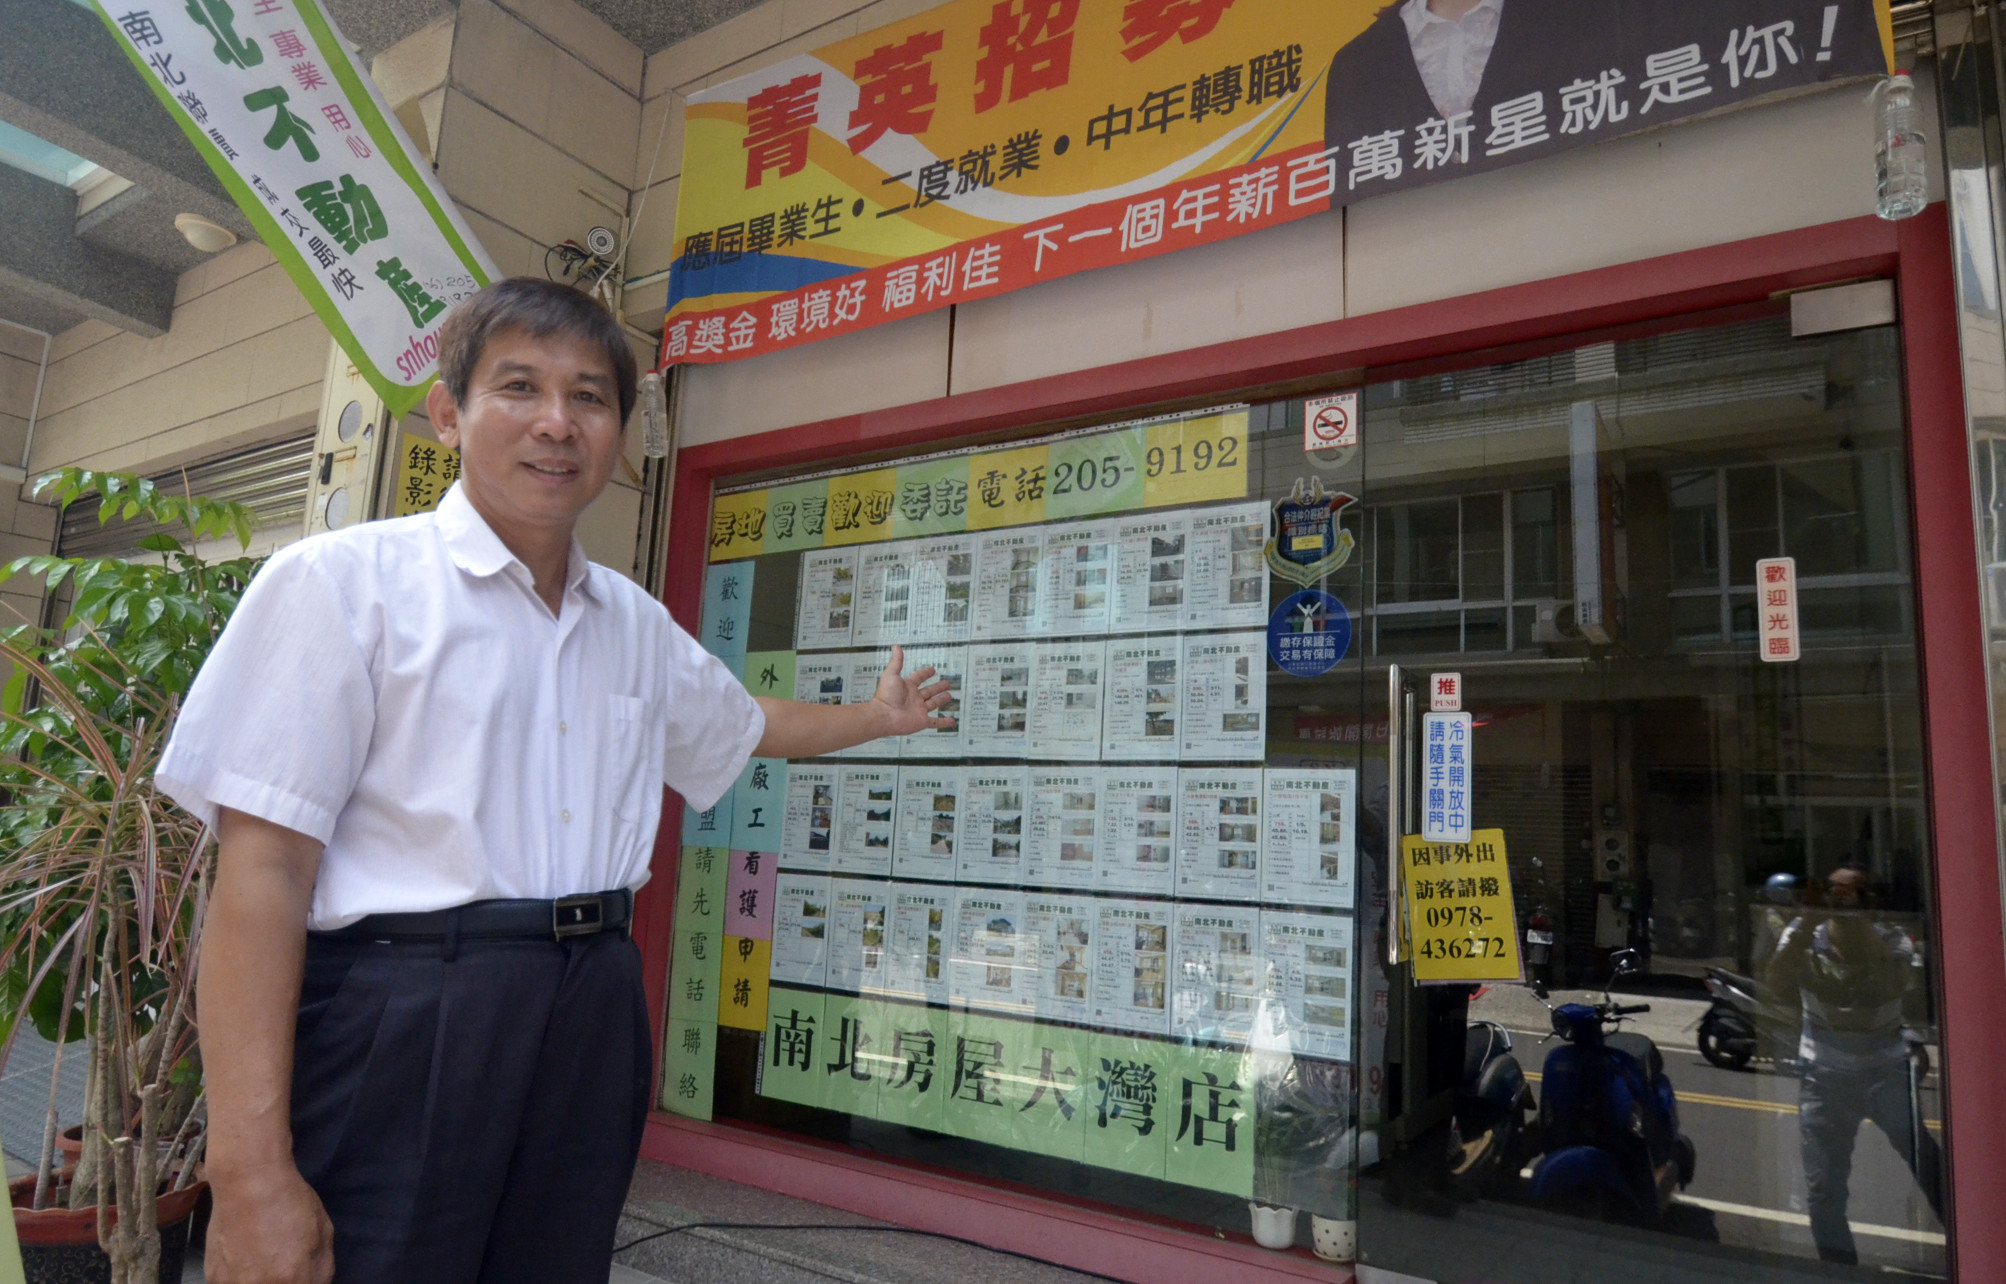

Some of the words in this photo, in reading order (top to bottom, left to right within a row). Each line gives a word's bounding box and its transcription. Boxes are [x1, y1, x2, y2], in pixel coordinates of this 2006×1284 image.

[681, 195, 843, 271] 應屆畢業生
[875, 128, 1043, 218] 二度就業
[1086, 44, 1304, 151] 中年轉職
[665, 310, 758, 361] 高獎金
[768, 279, 867, 341] 環境好
[883, 243, 1001, 312] 福利佳
[405, 444, 438, 507] 錄影
[977, 464, 1047, 508] 電話
[1052, 436, 1238, 495] 205-9192
[716, 576, 739, 641] 歡迎
[1765, 566, 1791, 655] 歡迎光臨
[1434, 699, 1458, 707] PUSH
[1437, 677, 1456, 696] 推
[1428, 720, 1446, 833] 請隨手關門
[1448, 720, 1465, 834] 冷氣開放中
[1411, 842, 1496, 867] 因事外出
[1415, 876, 1501, 901] 訪客請撥
[1426, 906, 1493, 928] 0978-
[1420, 937, 1507, 960] 436272
[772, 1009, 1244, 1152] 南北房屋大灣店
